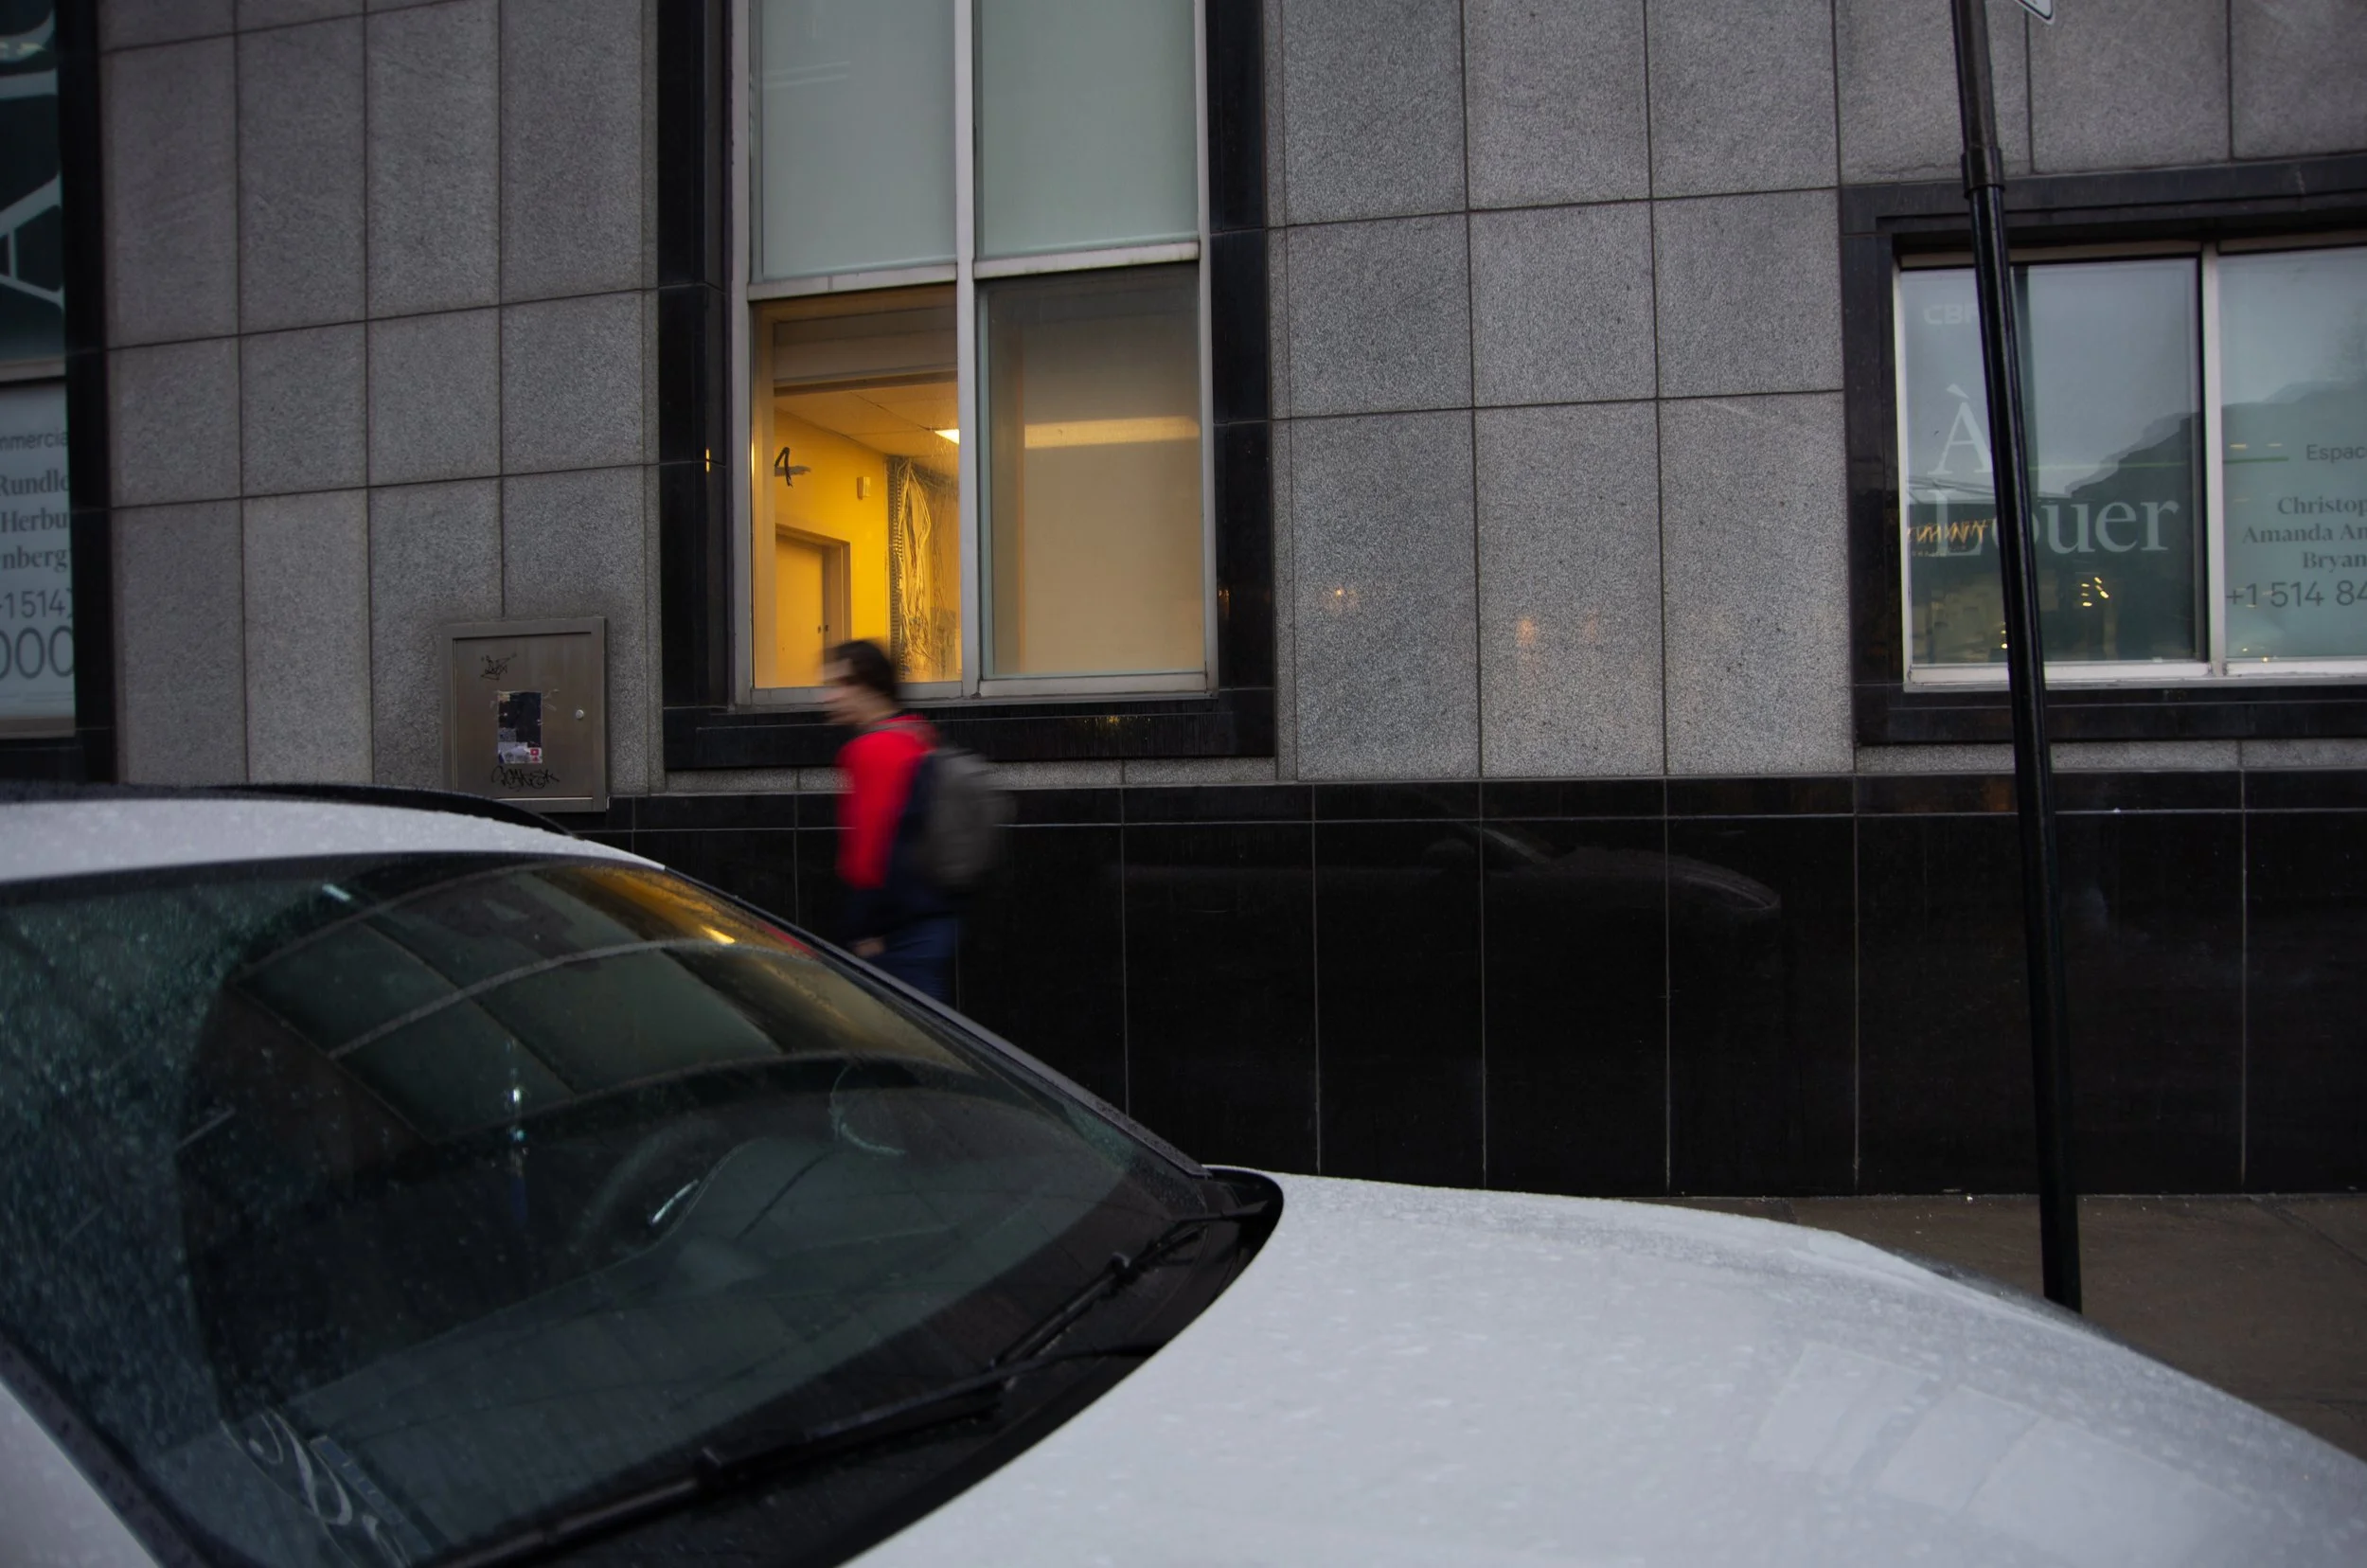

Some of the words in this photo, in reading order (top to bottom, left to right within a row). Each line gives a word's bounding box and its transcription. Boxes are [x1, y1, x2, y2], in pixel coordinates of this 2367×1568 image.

[2242, 524, 2333, 543] Amanda
[2303, 551, 2367, 573] Bryan
[2269, 579, 2325, 609] 514
